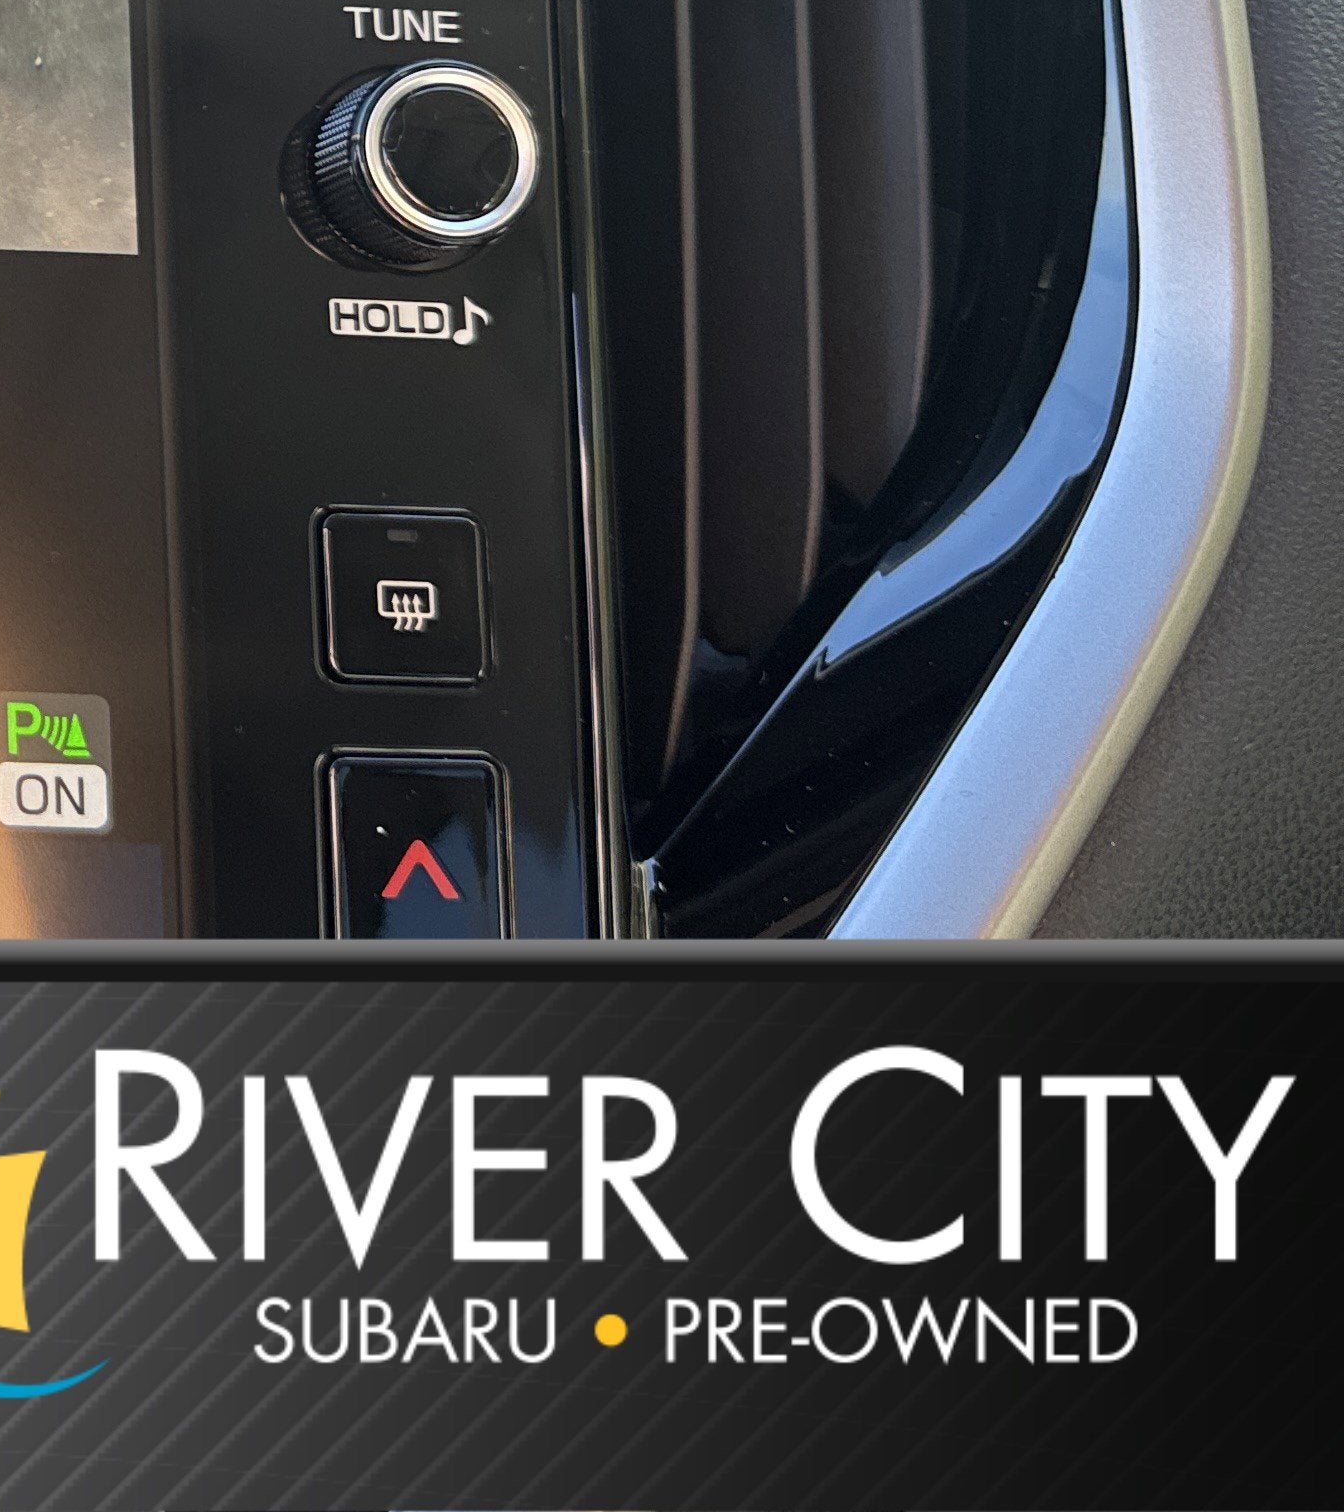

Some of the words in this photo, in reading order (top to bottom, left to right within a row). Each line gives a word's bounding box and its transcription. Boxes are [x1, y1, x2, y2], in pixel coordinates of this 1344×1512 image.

[342, 5, 464, 45] TUNE
[333, 303, 445, 336] HOLD
[15, 774, 86, 816] ON
